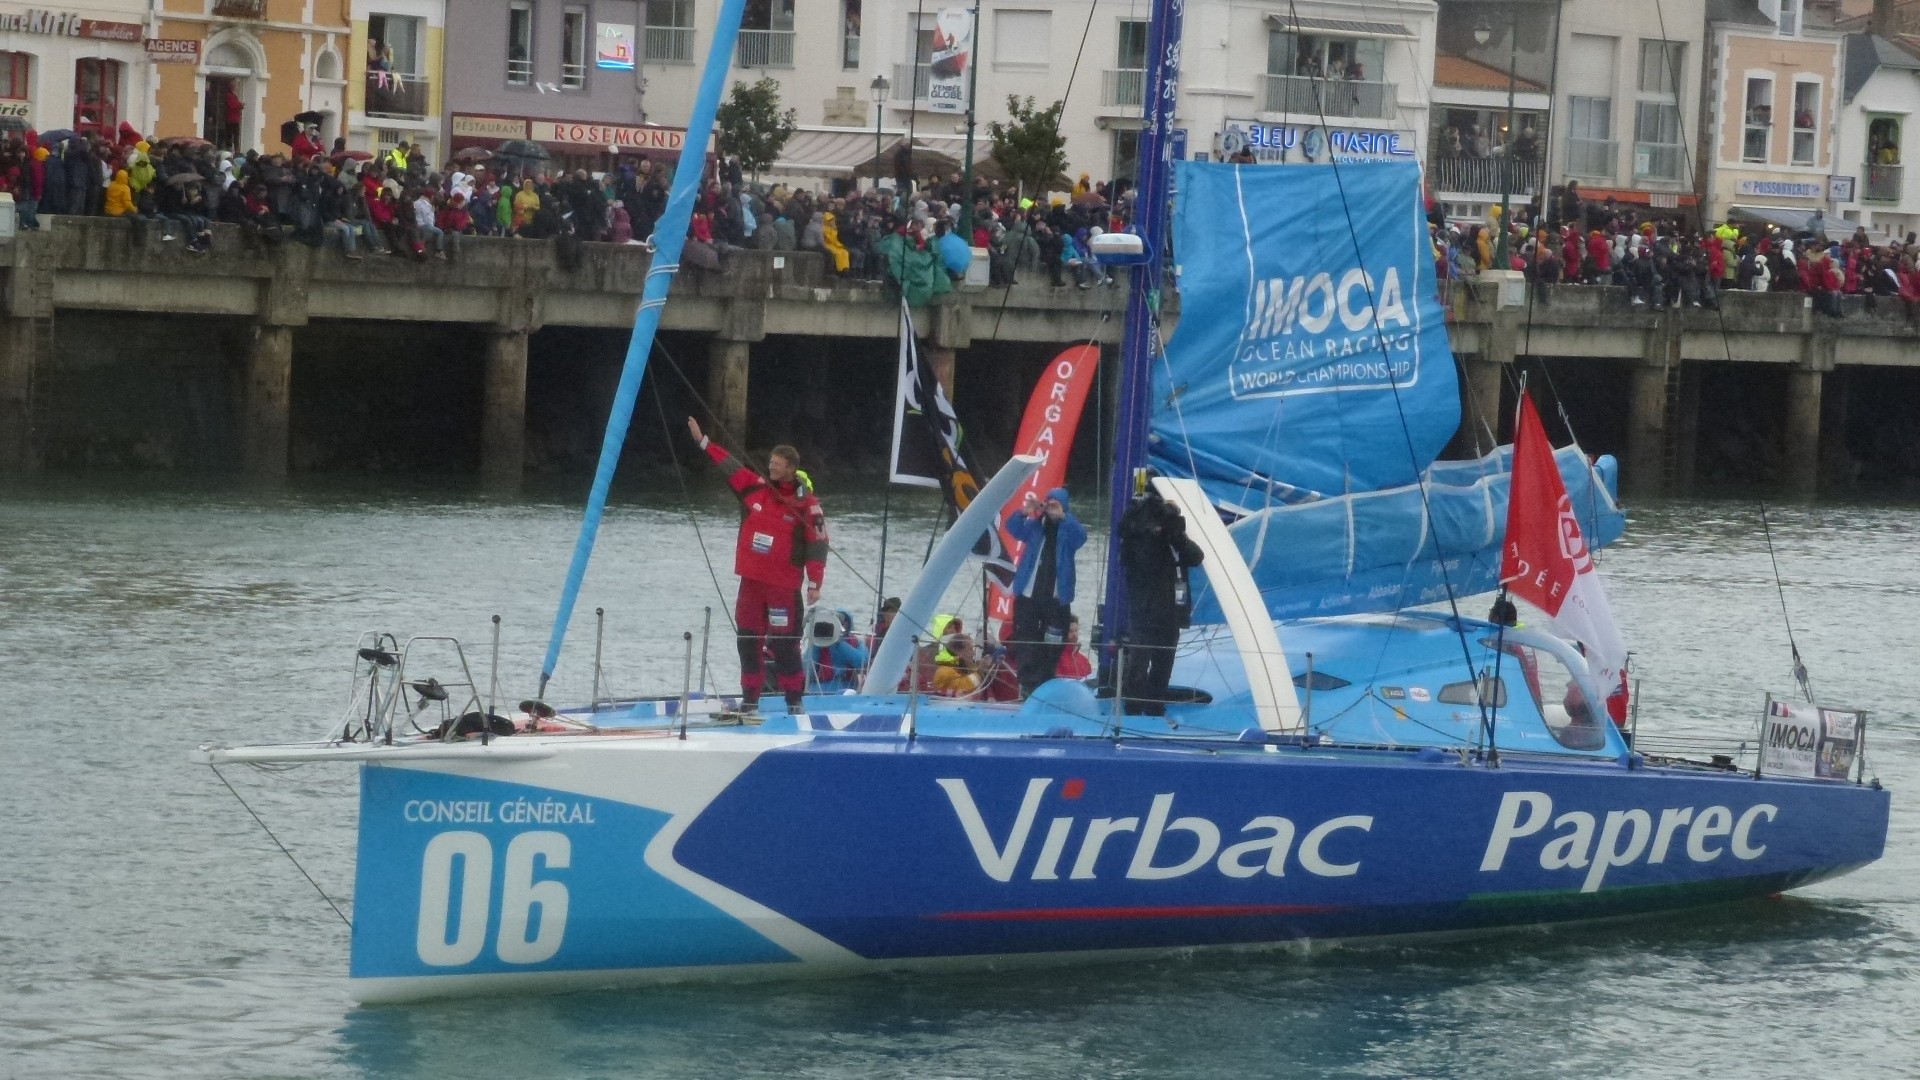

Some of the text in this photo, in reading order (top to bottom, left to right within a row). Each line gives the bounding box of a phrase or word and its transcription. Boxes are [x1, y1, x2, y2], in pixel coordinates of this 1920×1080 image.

[147, 39, 196, 53] AGENCE
[930, 90, 963, 100] GLOBE
[454, 122, 525, 135] RESTAURANT
[554, 124, 687, 148] ROSEMOND
[1249, 125, 1415, 156] BLEU MARINE
[1752, 181, 1811, 196] POISSONNERIE
[1248, 266, 1411, 339] IMOCA
[1241, 333, 1411, 362] OCEAN RACING
[1240, 361, 1410, 389] WORLD CHAMPIONSHIP
[1769, 722, 1816, 751] IMOCA
[404, 797, 595, 824] CONSEIL GÉNÉRAL
[936, 778, 1374, 882] Virbac
[1479, 791, 1778, 893] Paprec
[416, 830, 571, 966] 06
